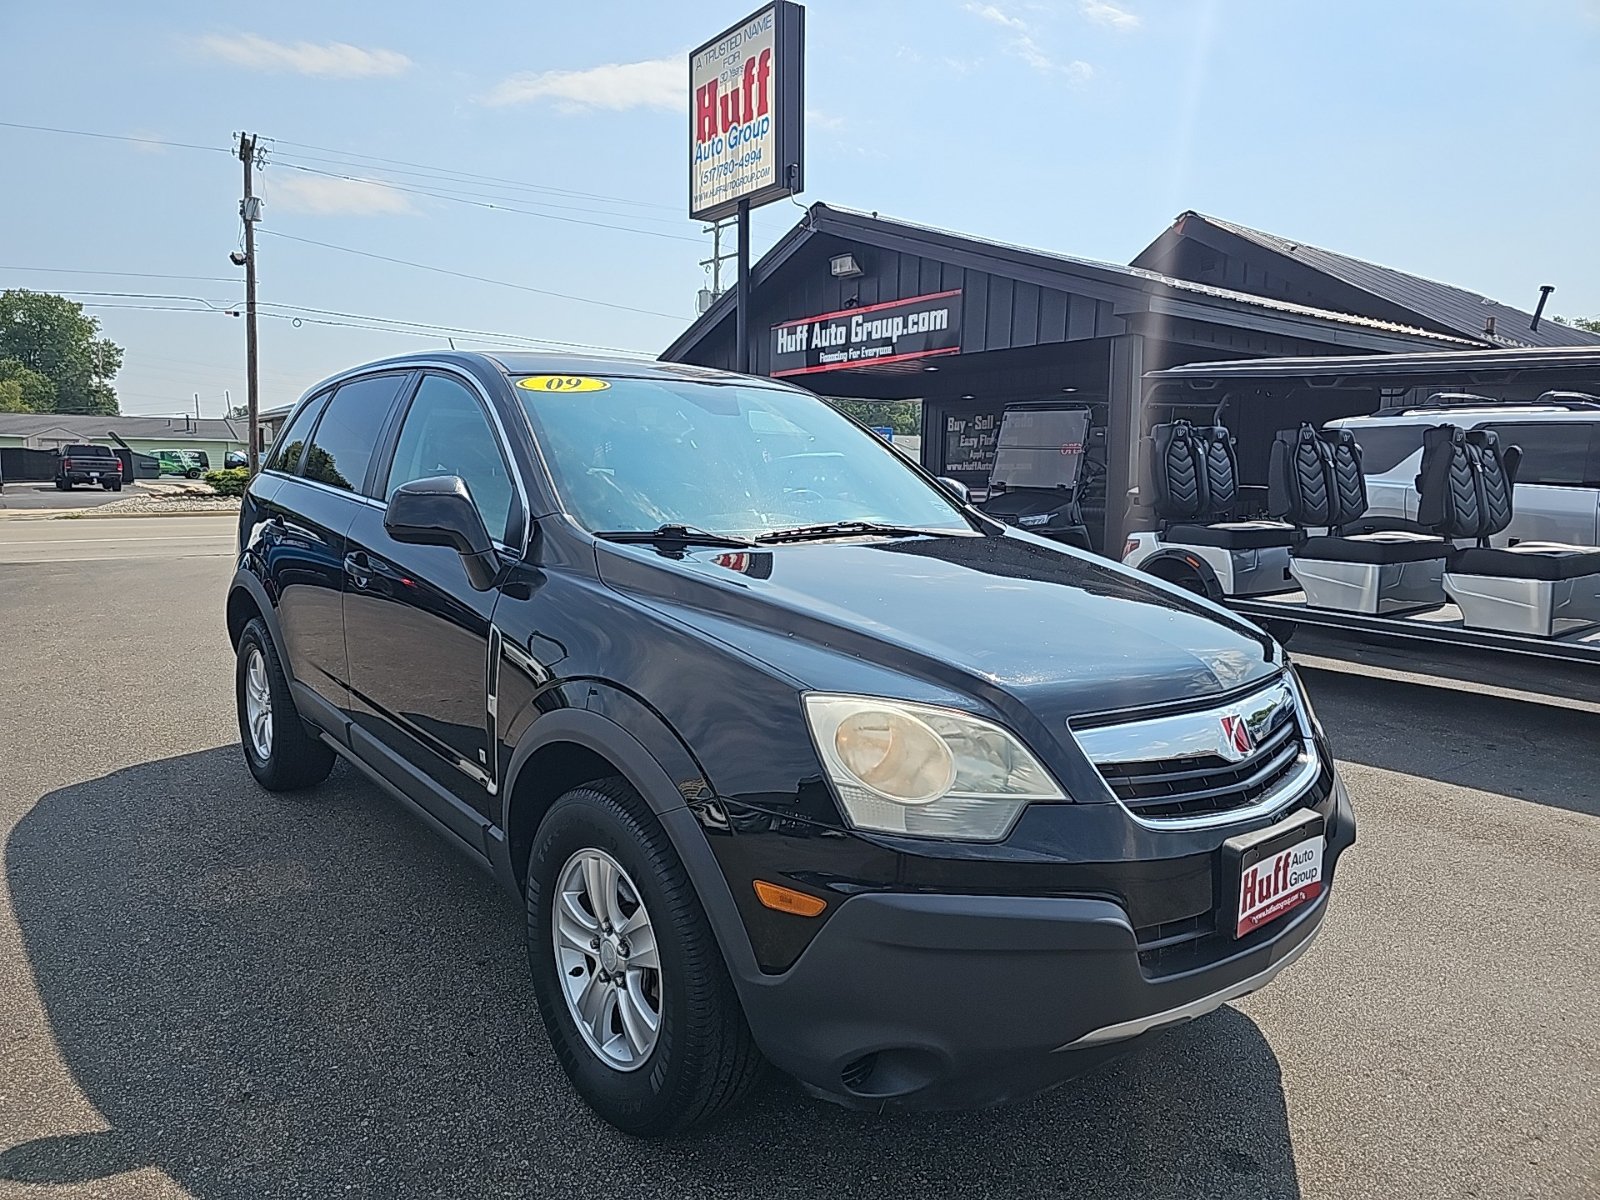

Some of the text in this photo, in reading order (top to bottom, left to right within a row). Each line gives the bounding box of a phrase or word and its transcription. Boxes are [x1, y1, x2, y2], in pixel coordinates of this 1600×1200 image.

[696, 13, 773, 72] A TRUSTED NAME
[722, 50, 741, 69] FOR
[696, 47, 771, 145] Huff
[694, 116, 770, 166] Auto Group
[700, 146, 762, 188] (517)780-4994
[777, 308, 949, 354] Huff Auto Group.com
[848, 347, 861, 360] For
[860, 345, 893, 359] Everyone
[545, 377, 582, 390] 09
[947, 417, 966, 434] Buy
[974, 414, 994, 430] Sell
[960, 434, 978, 448] Easy
[1240, 849, 1314, 916] Huff Auto
[1289, 867, 1318, 887] Group
